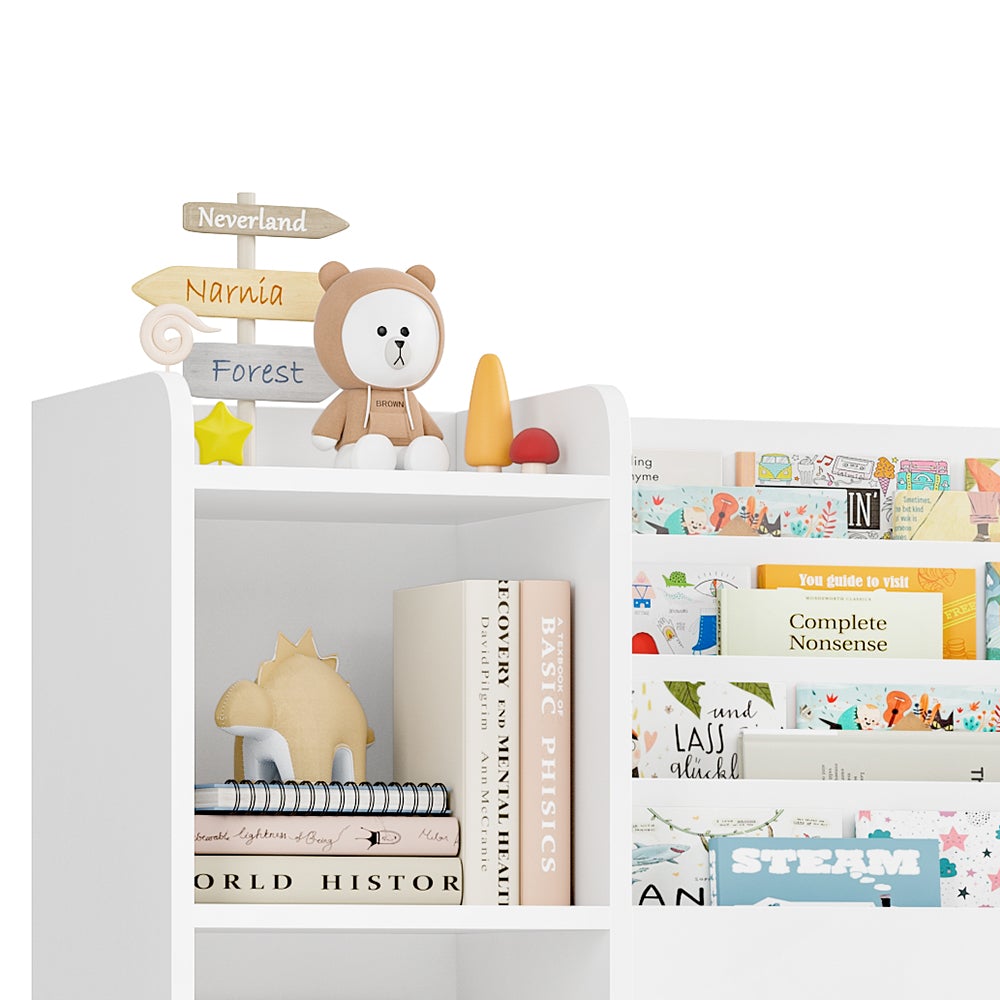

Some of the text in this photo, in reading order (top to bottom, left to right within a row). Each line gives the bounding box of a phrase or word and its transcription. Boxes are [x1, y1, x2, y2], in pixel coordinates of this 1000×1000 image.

[198, 207, 308, 232] Neverland
[186, 276, 283, 306] Narnia
[212, 359, 304, 384] Forest
[376, 400, 405, 408] BROWN
[631, 455, 653, 470] ing
[799, 574, 909, 588] You guide to visit
[557, 617, 564, 626] A
[789, 613, 888, 635] Complete
[481, 616, 490, 665] David
[789, 635, 888, 652] Nonsense
[479, 671, 490, 731] Pilgrim
[557, 701, 564, 717] OF
[707, 700, 757, 718] und
[541, 616, 556, 873] BASIC PHISICS
[481, 752, 490, 785] Ann
[498, 735, 510, 825] MENTAL
[498, 831, 510, 906] HEALT
[731, 847, 921, 876] STEAM
[321, 874, 459, 891] HISTOR
